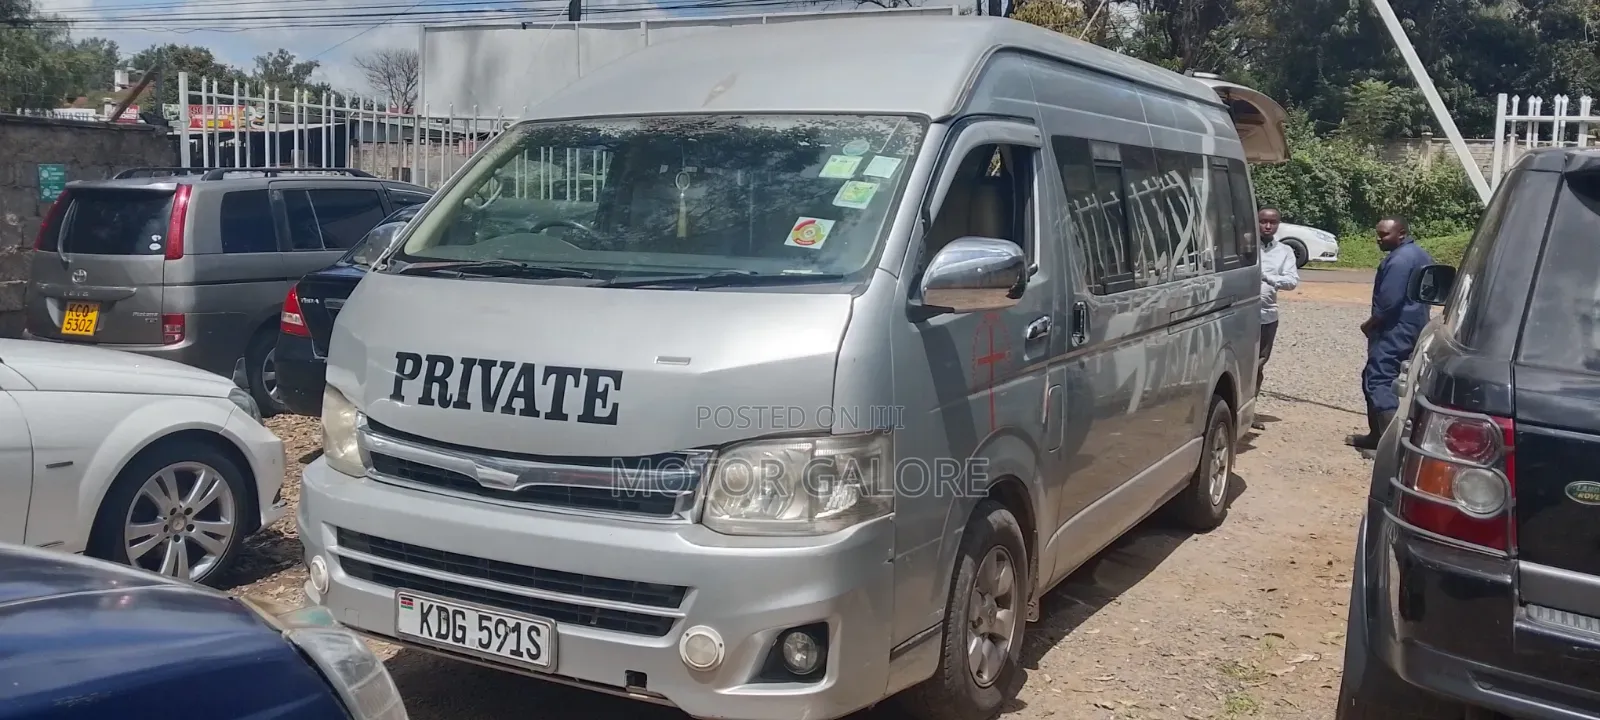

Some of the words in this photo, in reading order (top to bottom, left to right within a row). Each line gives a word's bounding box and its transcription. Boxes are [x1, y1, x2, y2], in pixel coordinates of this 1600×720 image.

[68, 303, 90, 318] KCQ
[65, 318, 93, 332] 530Z
[389, 351, 623, 425] PRIVATE
[1577, 492, 1600, 501] ROVE
[419, 601, 467, 645] KDG
[478, 614, 542, 661] 591S
